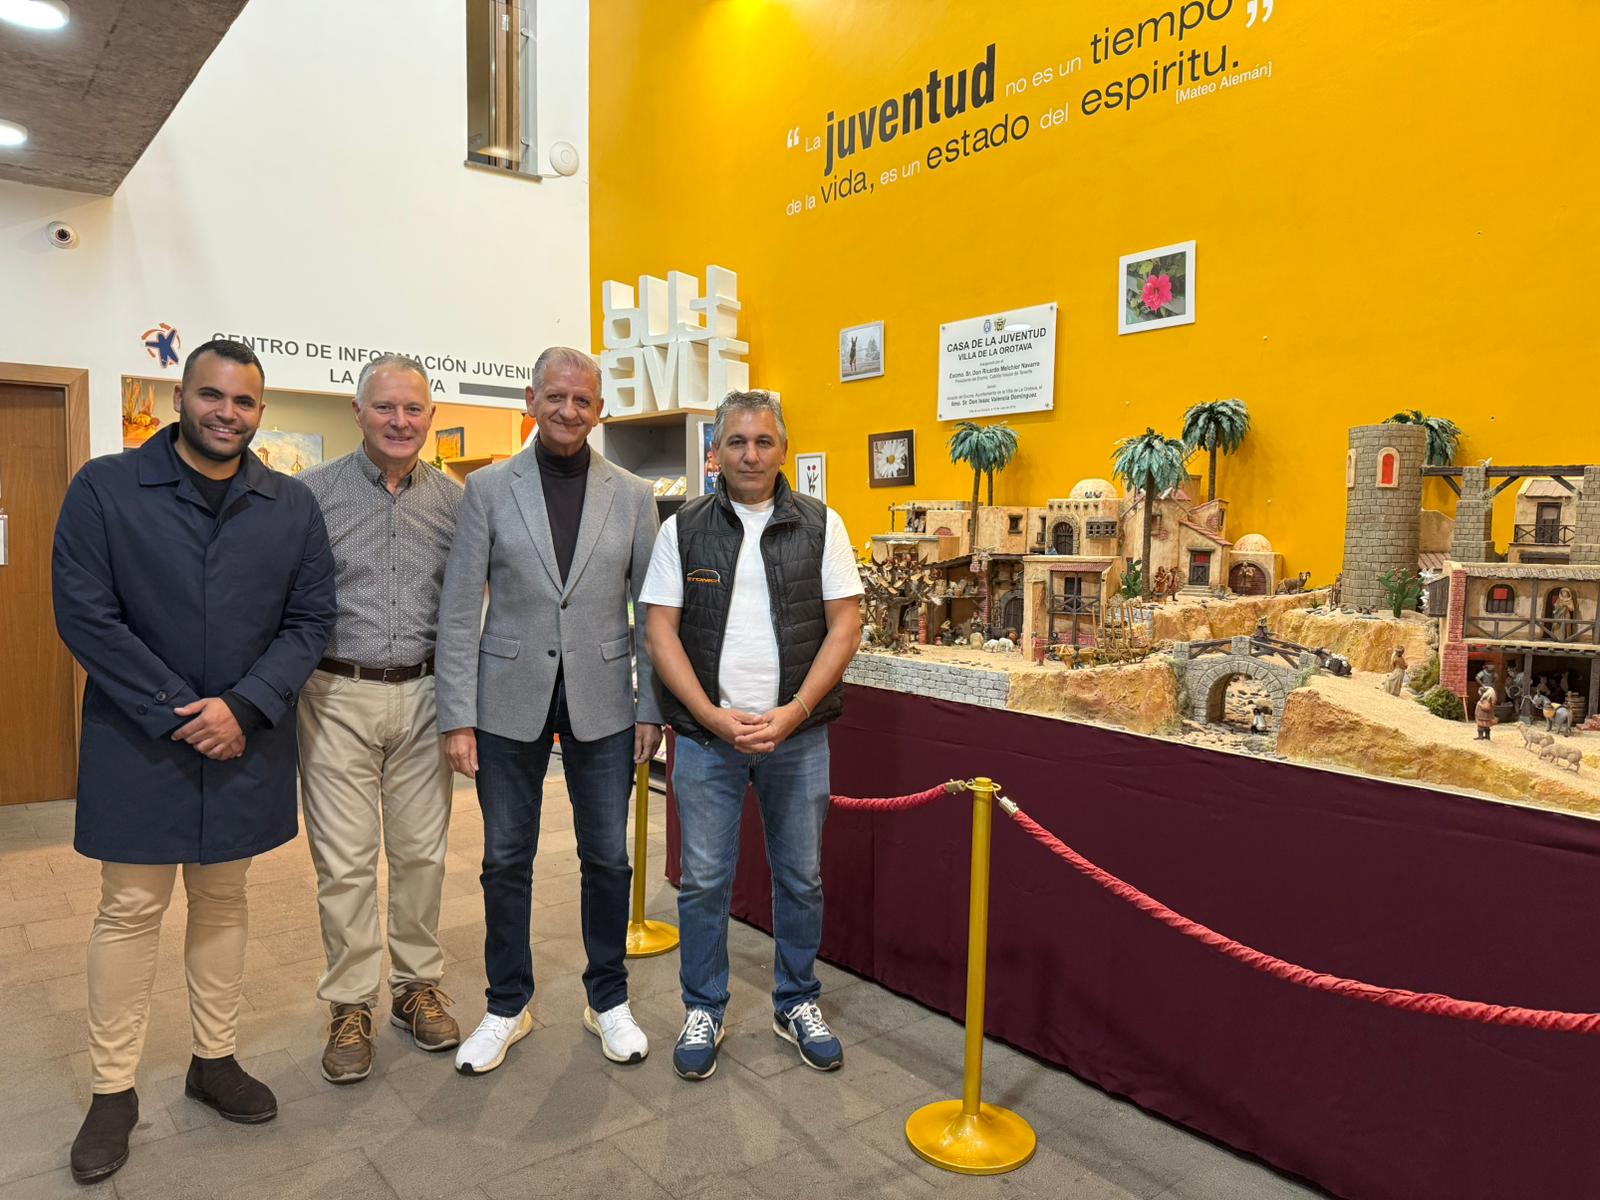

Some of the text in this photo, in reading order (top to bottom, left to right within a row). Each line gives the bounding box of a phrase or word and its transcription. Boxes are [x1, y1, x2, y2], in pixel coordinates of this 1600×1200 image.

[805, 136, 821, 152] La
[824, 43, 996, 176] juventud
[1005, 77, 1027, 97] no
[1032, 67, 1053, 87] es
[1059, 56, 1081, 77] un
[1090, 0, 1233, 64] tiempo
[1175, 80, 1217, 104] [Mateo
[786, 44, 1239, 216] de la vida, es un estado del espiritu.
[947, 327, 1047, 352] CASA DE LA JUVENTUD
[306, 343, 332, 359] DE
[472, 361, 532, 380] JUVENI
[957, 343, 1033, 361] VILLA DE LA OROTAVA
[330, 368, 355, 385] LA
[1021, 361, 1040, 369] Navarro
